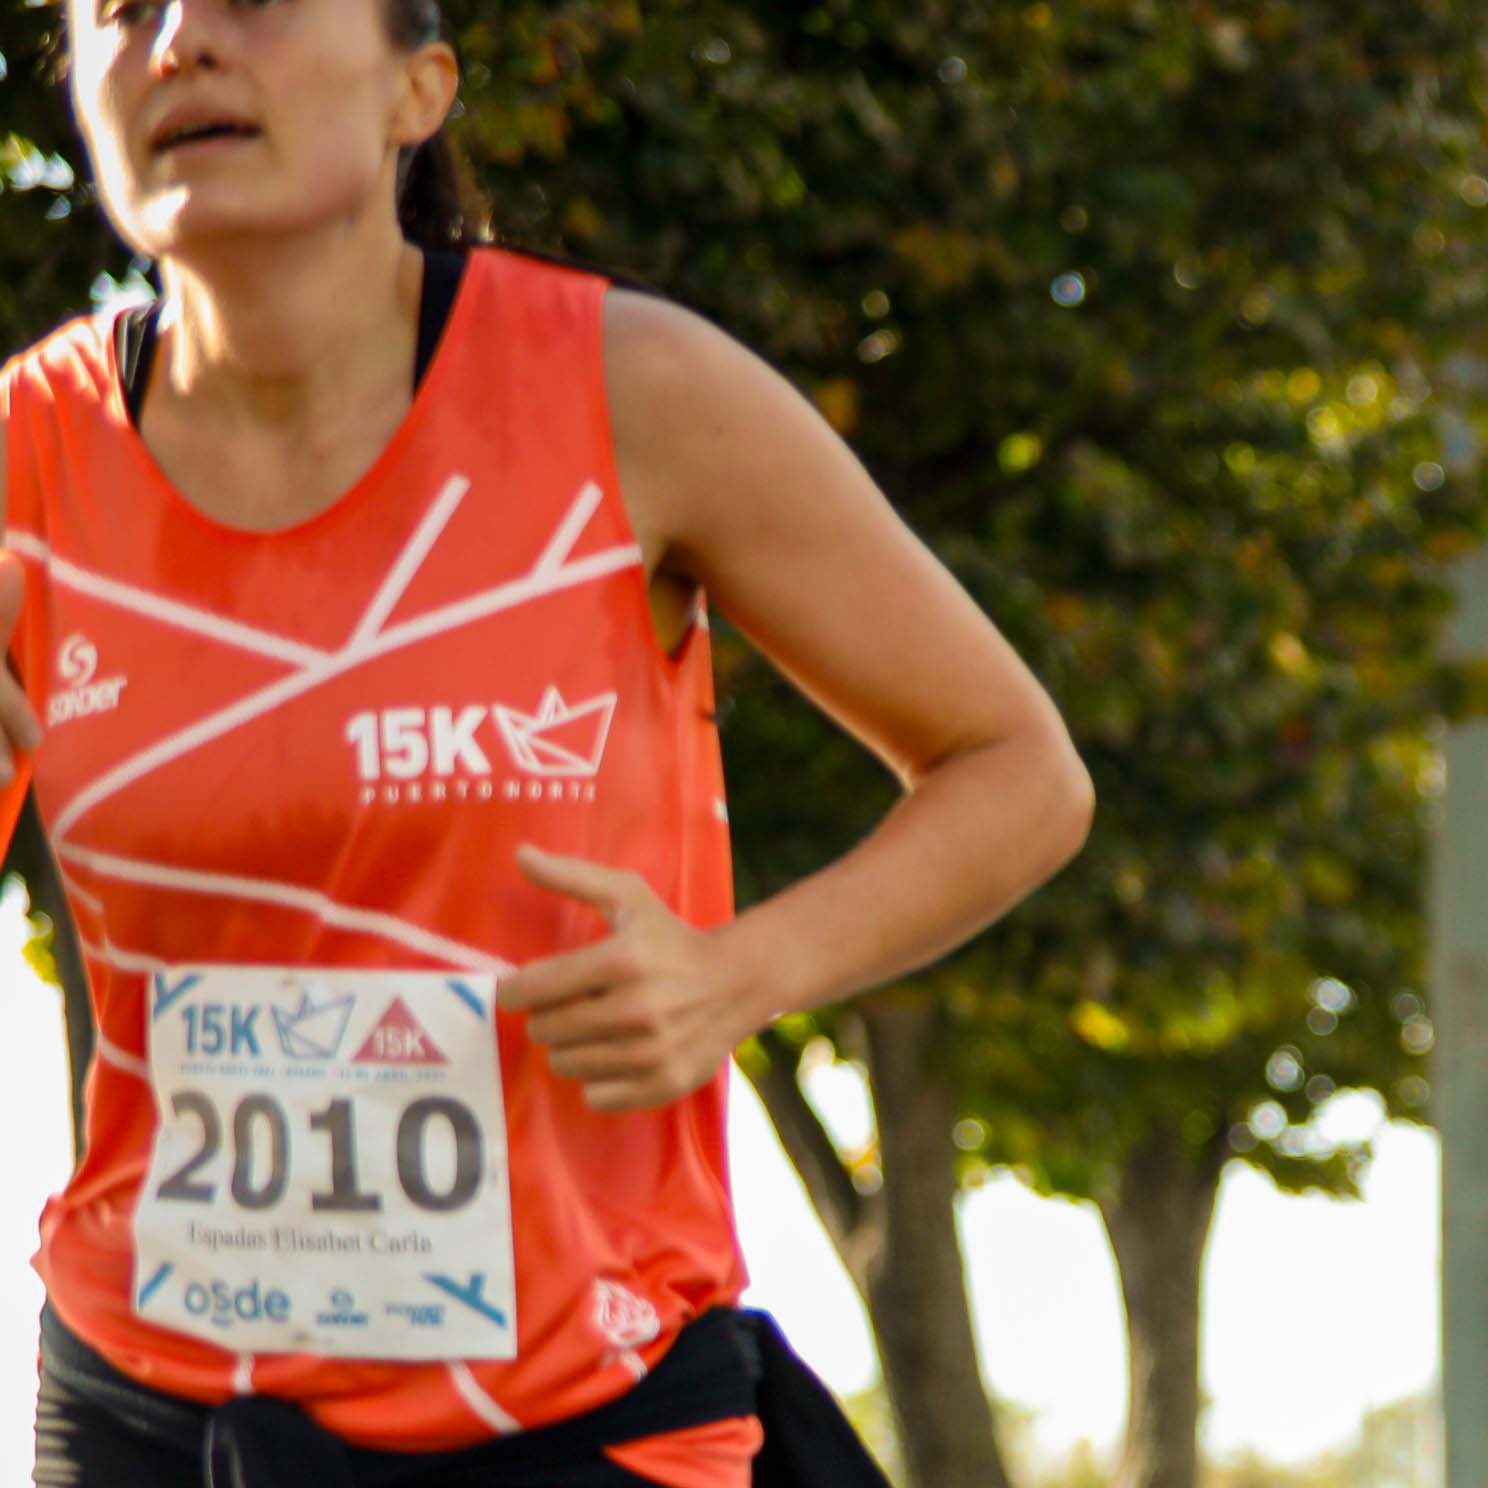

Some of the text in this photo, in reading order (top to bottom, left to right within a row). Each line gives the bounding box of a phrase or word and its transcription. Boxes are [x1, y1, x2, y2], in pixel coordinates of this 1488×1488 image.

[345, 704, 492, 781] 15K
[181, 1004, 263, 1056] 15K
[371, 1030, 428, 1060] 15K
[156, 1089, 484, 1213] 2010
[184, 1276, 292, 1327] osde
